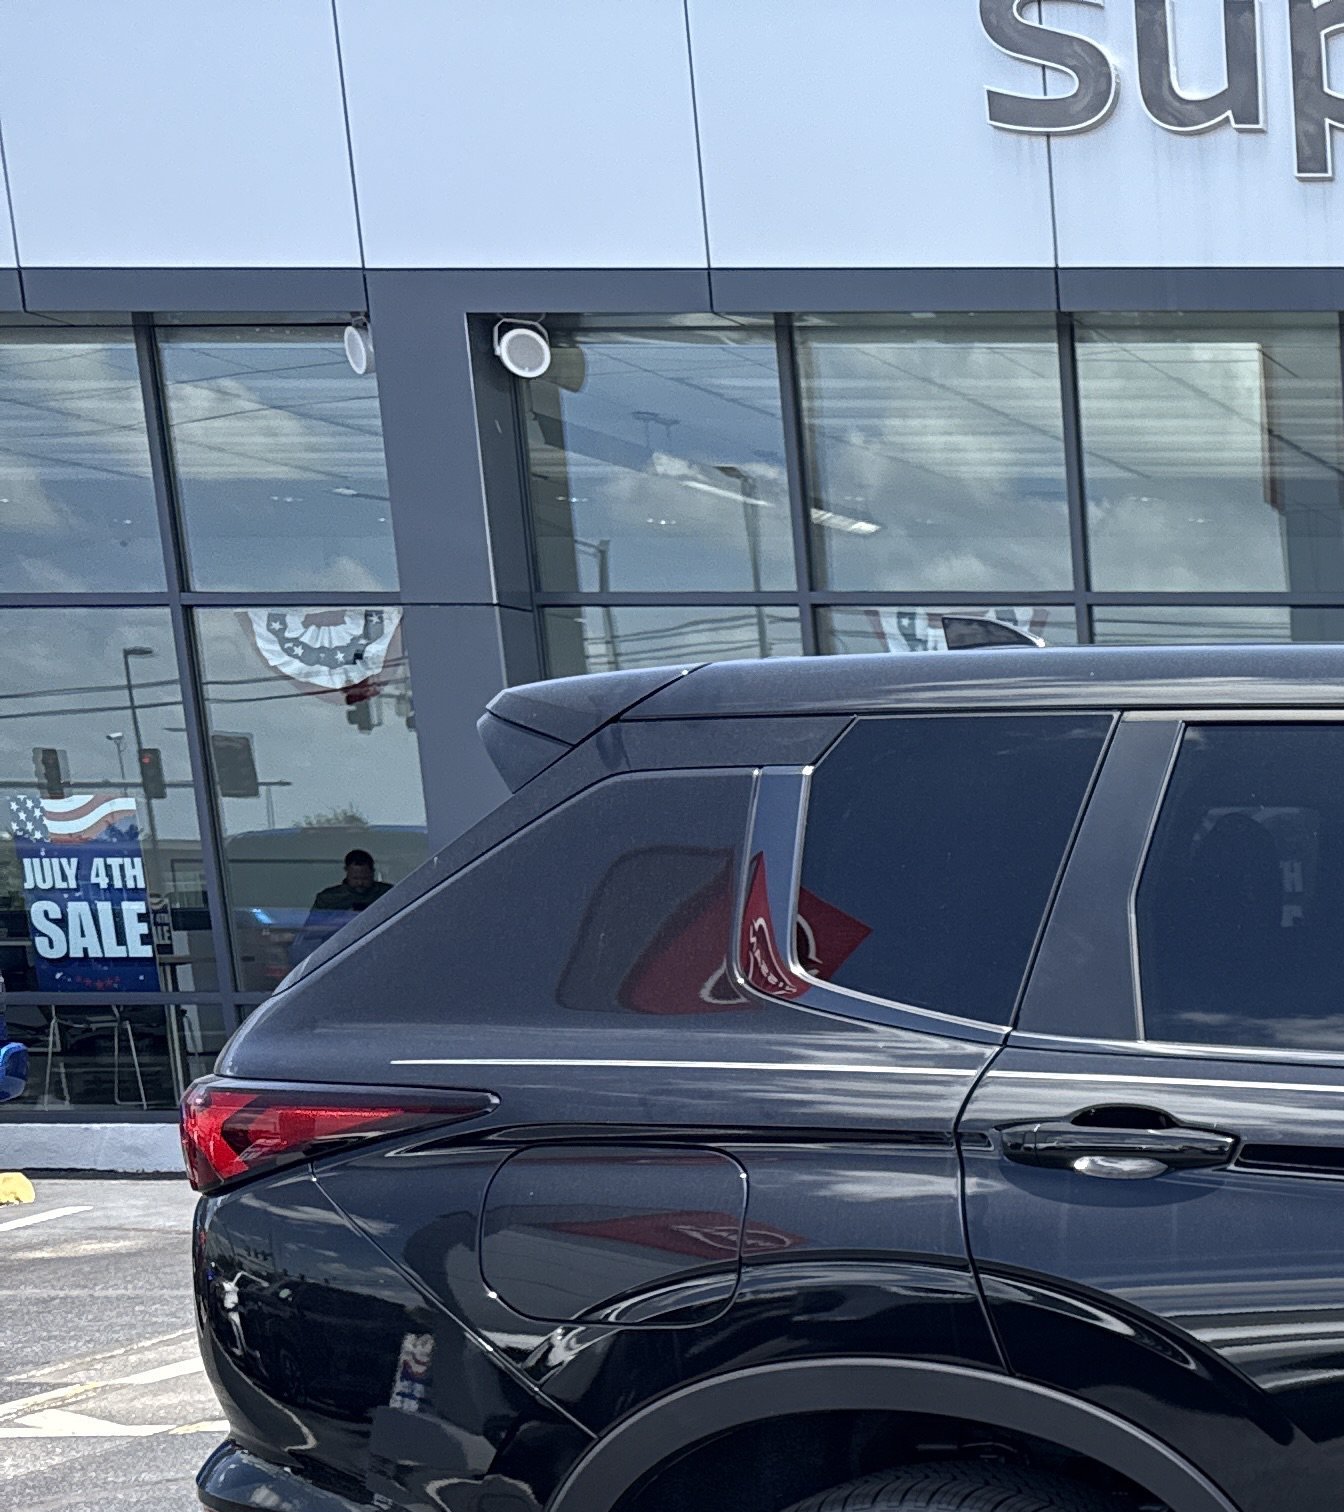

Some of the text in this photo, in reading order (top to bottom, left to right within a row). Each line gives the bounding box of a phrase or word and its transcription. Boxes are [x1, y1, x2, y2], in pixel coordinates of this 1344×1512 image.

[23, 857, 146, 889] JULY 4TH
[30, 900, 153, 959] SALE
